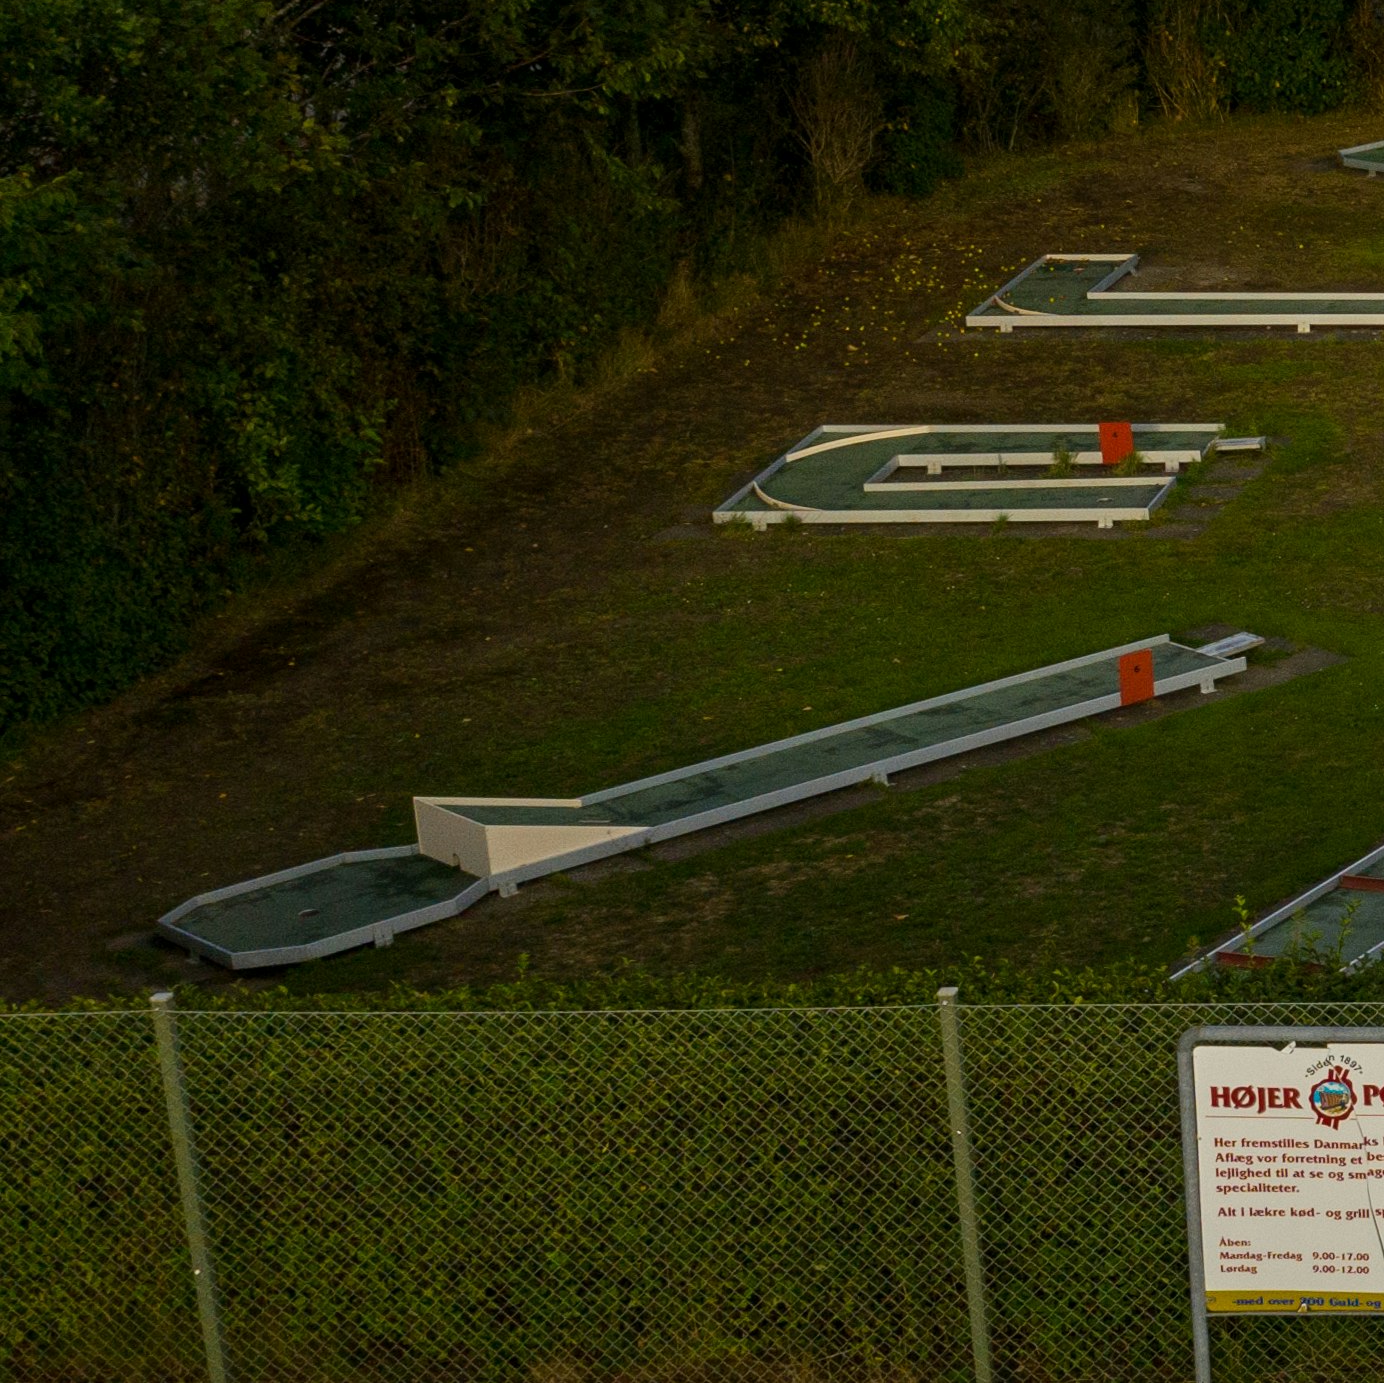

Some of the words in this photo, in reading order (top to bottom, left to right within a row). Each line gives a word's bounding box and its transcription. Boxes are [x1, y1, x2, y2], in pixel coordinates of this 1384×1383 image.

[1210, 1085, 1303, 1114] HØJER
[1214, 1137, 1237, 1148] Her
[1241, 1137, 1310, 1149] fremstilles
[1313, 1136, 1379, 1150] Danmarks
[1215, 1152, 1254, 1165] Aflæg
[1256, 1155, 1277, 1163] vor
[1281, 1153, 1346, 1167] forretning
[1350, 1156, 1363, 1164] et
[1215, 1168, 1271, 1180] lejlighed
[1275, 1168, 1289, 1178] til
[1293, 1169, 1306, 1178] at
[1309, 1171, 1324, 1179] se
[1328, 1170, 1345, 1181] og
[1215, 1183, 1300, 1195] specialiteter.
[1218, 1206, 1237, 1217] Alt
[1249, 1206, 1286, 1217] lækre
[1290, 1206, 1321, 1218] kød-
[1325, 1209, 1342, 1220] og
[1345, 1208, 1370, 1220] grill
[1219, 1236, 1252, 1247] Åben:
[1219, 1251, 1303, 1262] Mandag-Fredag
[1312, 1251, 1370, 1261] 9.00-17.00
[1220, 1264, 1258, 1274] Lørdag
[1312, 1265, 1370, 1274] 9.00-12.00
[1366, 1299, 1381, 1308] og
